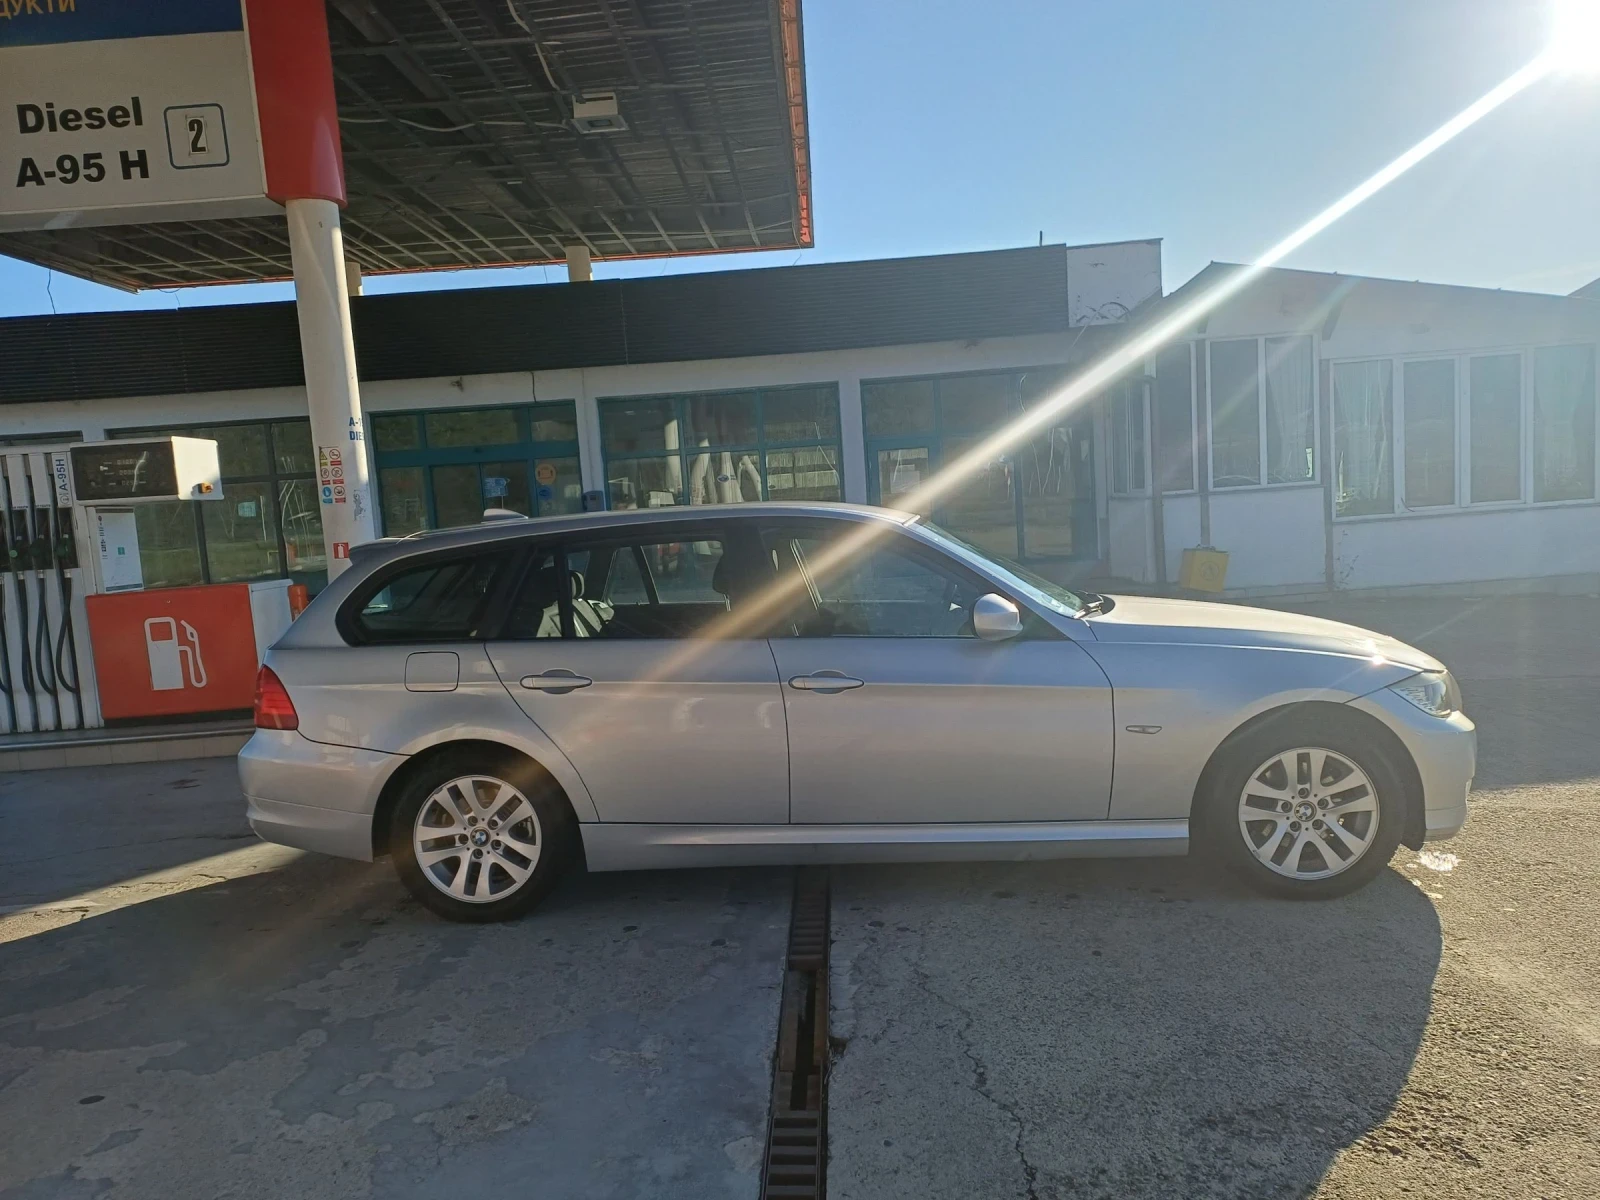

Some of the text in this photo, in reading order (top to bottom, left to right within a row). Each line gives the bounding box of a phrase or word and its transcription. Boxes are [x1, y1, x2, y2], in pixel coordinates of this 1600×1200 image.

[16, 97, 143, 134] Diesel
[188, 119, 206, 153] 2
[16, 149, 150, 188] A-95 H
